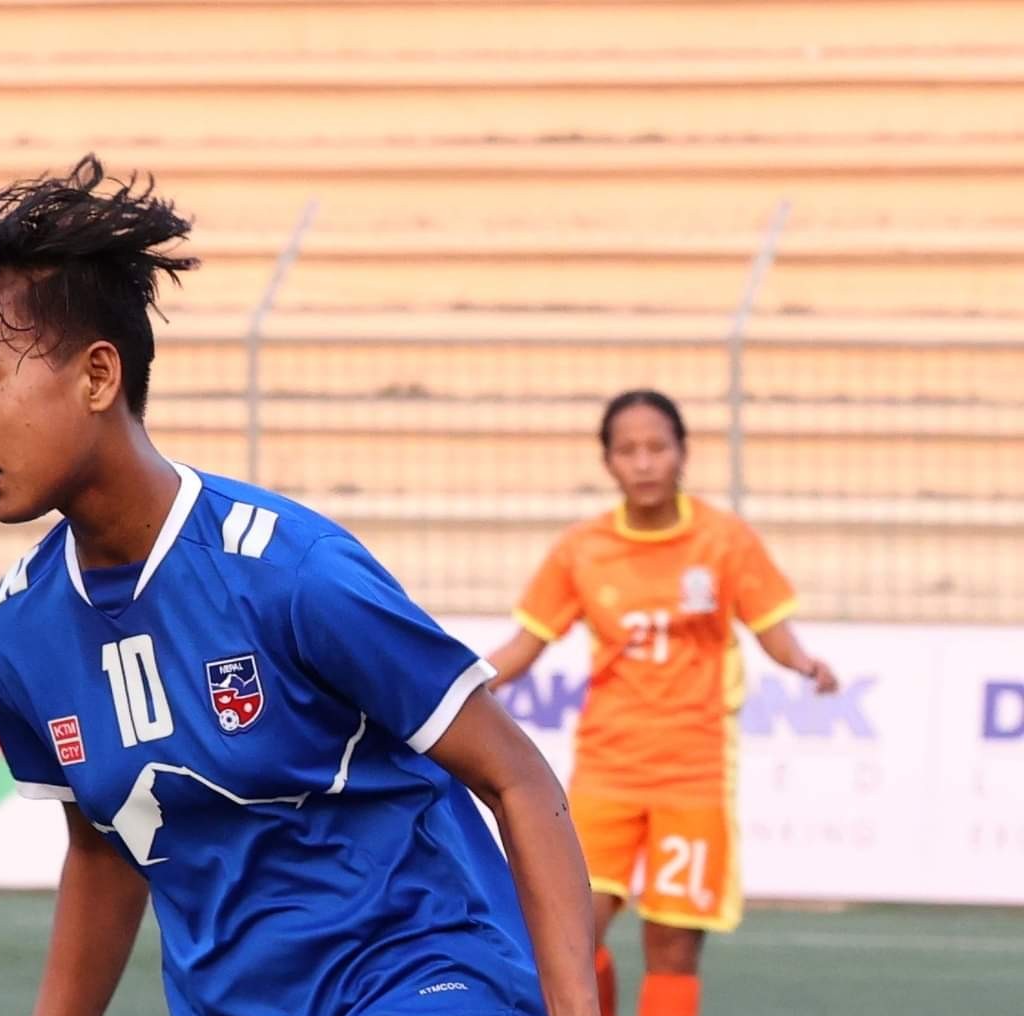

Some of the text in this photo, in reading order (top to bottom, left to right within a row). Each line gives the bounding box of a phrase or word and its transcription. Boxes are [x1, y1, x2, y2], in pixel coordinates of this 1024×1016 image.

[102, 633, 174, 749] 10
[53, 721, 77, 738] KTM
[61, 745, 81, 760] CTY
[654, 833, 709, 898] 21
